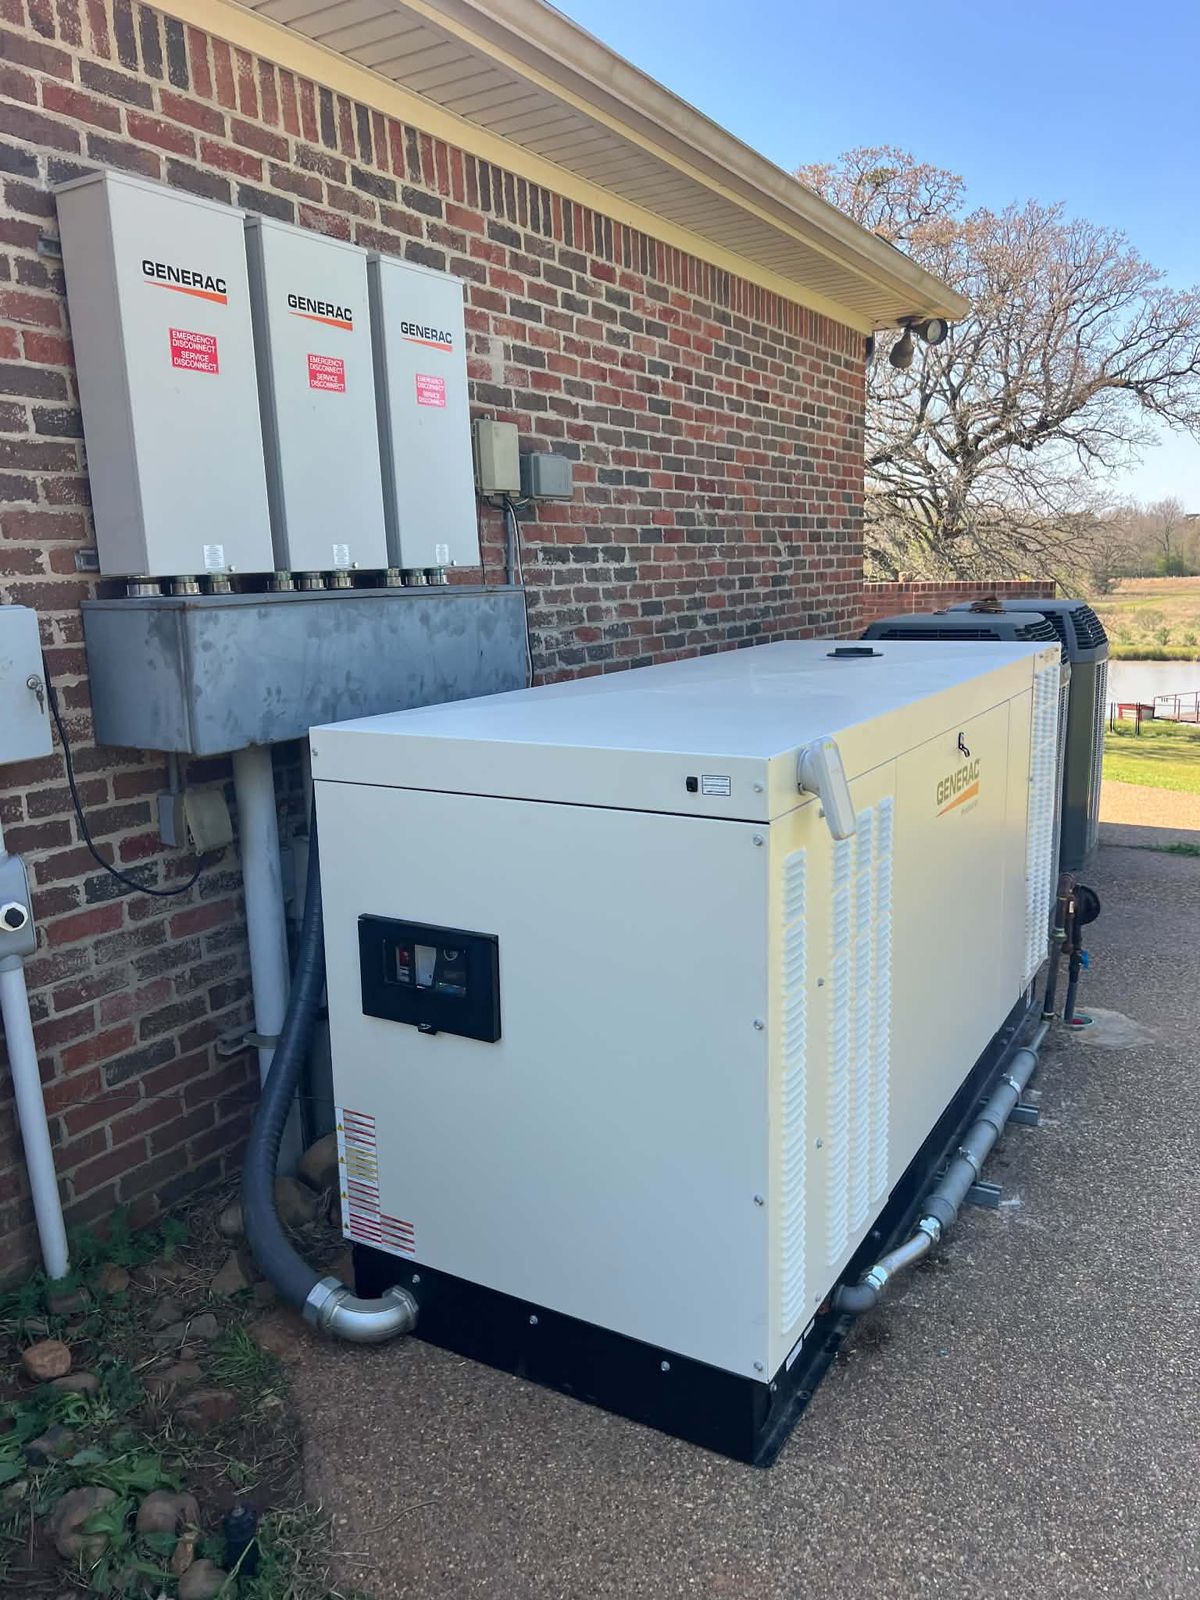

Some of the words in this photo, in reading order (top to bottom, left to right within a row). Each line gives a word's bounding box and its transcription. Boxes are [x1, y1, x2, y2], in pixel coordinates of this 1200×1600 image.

[142, 259, 227, 294] GENERAC
[287, 293, 353, 321] GENERAC
[172, 330, 215, 345] EMERGENCY
[400, 321, 453, 344] GENERAC
[172, 339, 215, 353] DISCONNECT
[181, 350, 209, 363] SERVICE
[309, 355, 342, 367] EMERGENCY
[174, 357, 217, 371] DISCONNECT
[309, 363, 343, 374] DISCONNECT
[310, 379, 344, 390] DISCONNECT
[316, 373, 338, 383] SERVICE
[936, 758, 980, 806] GENERAC
